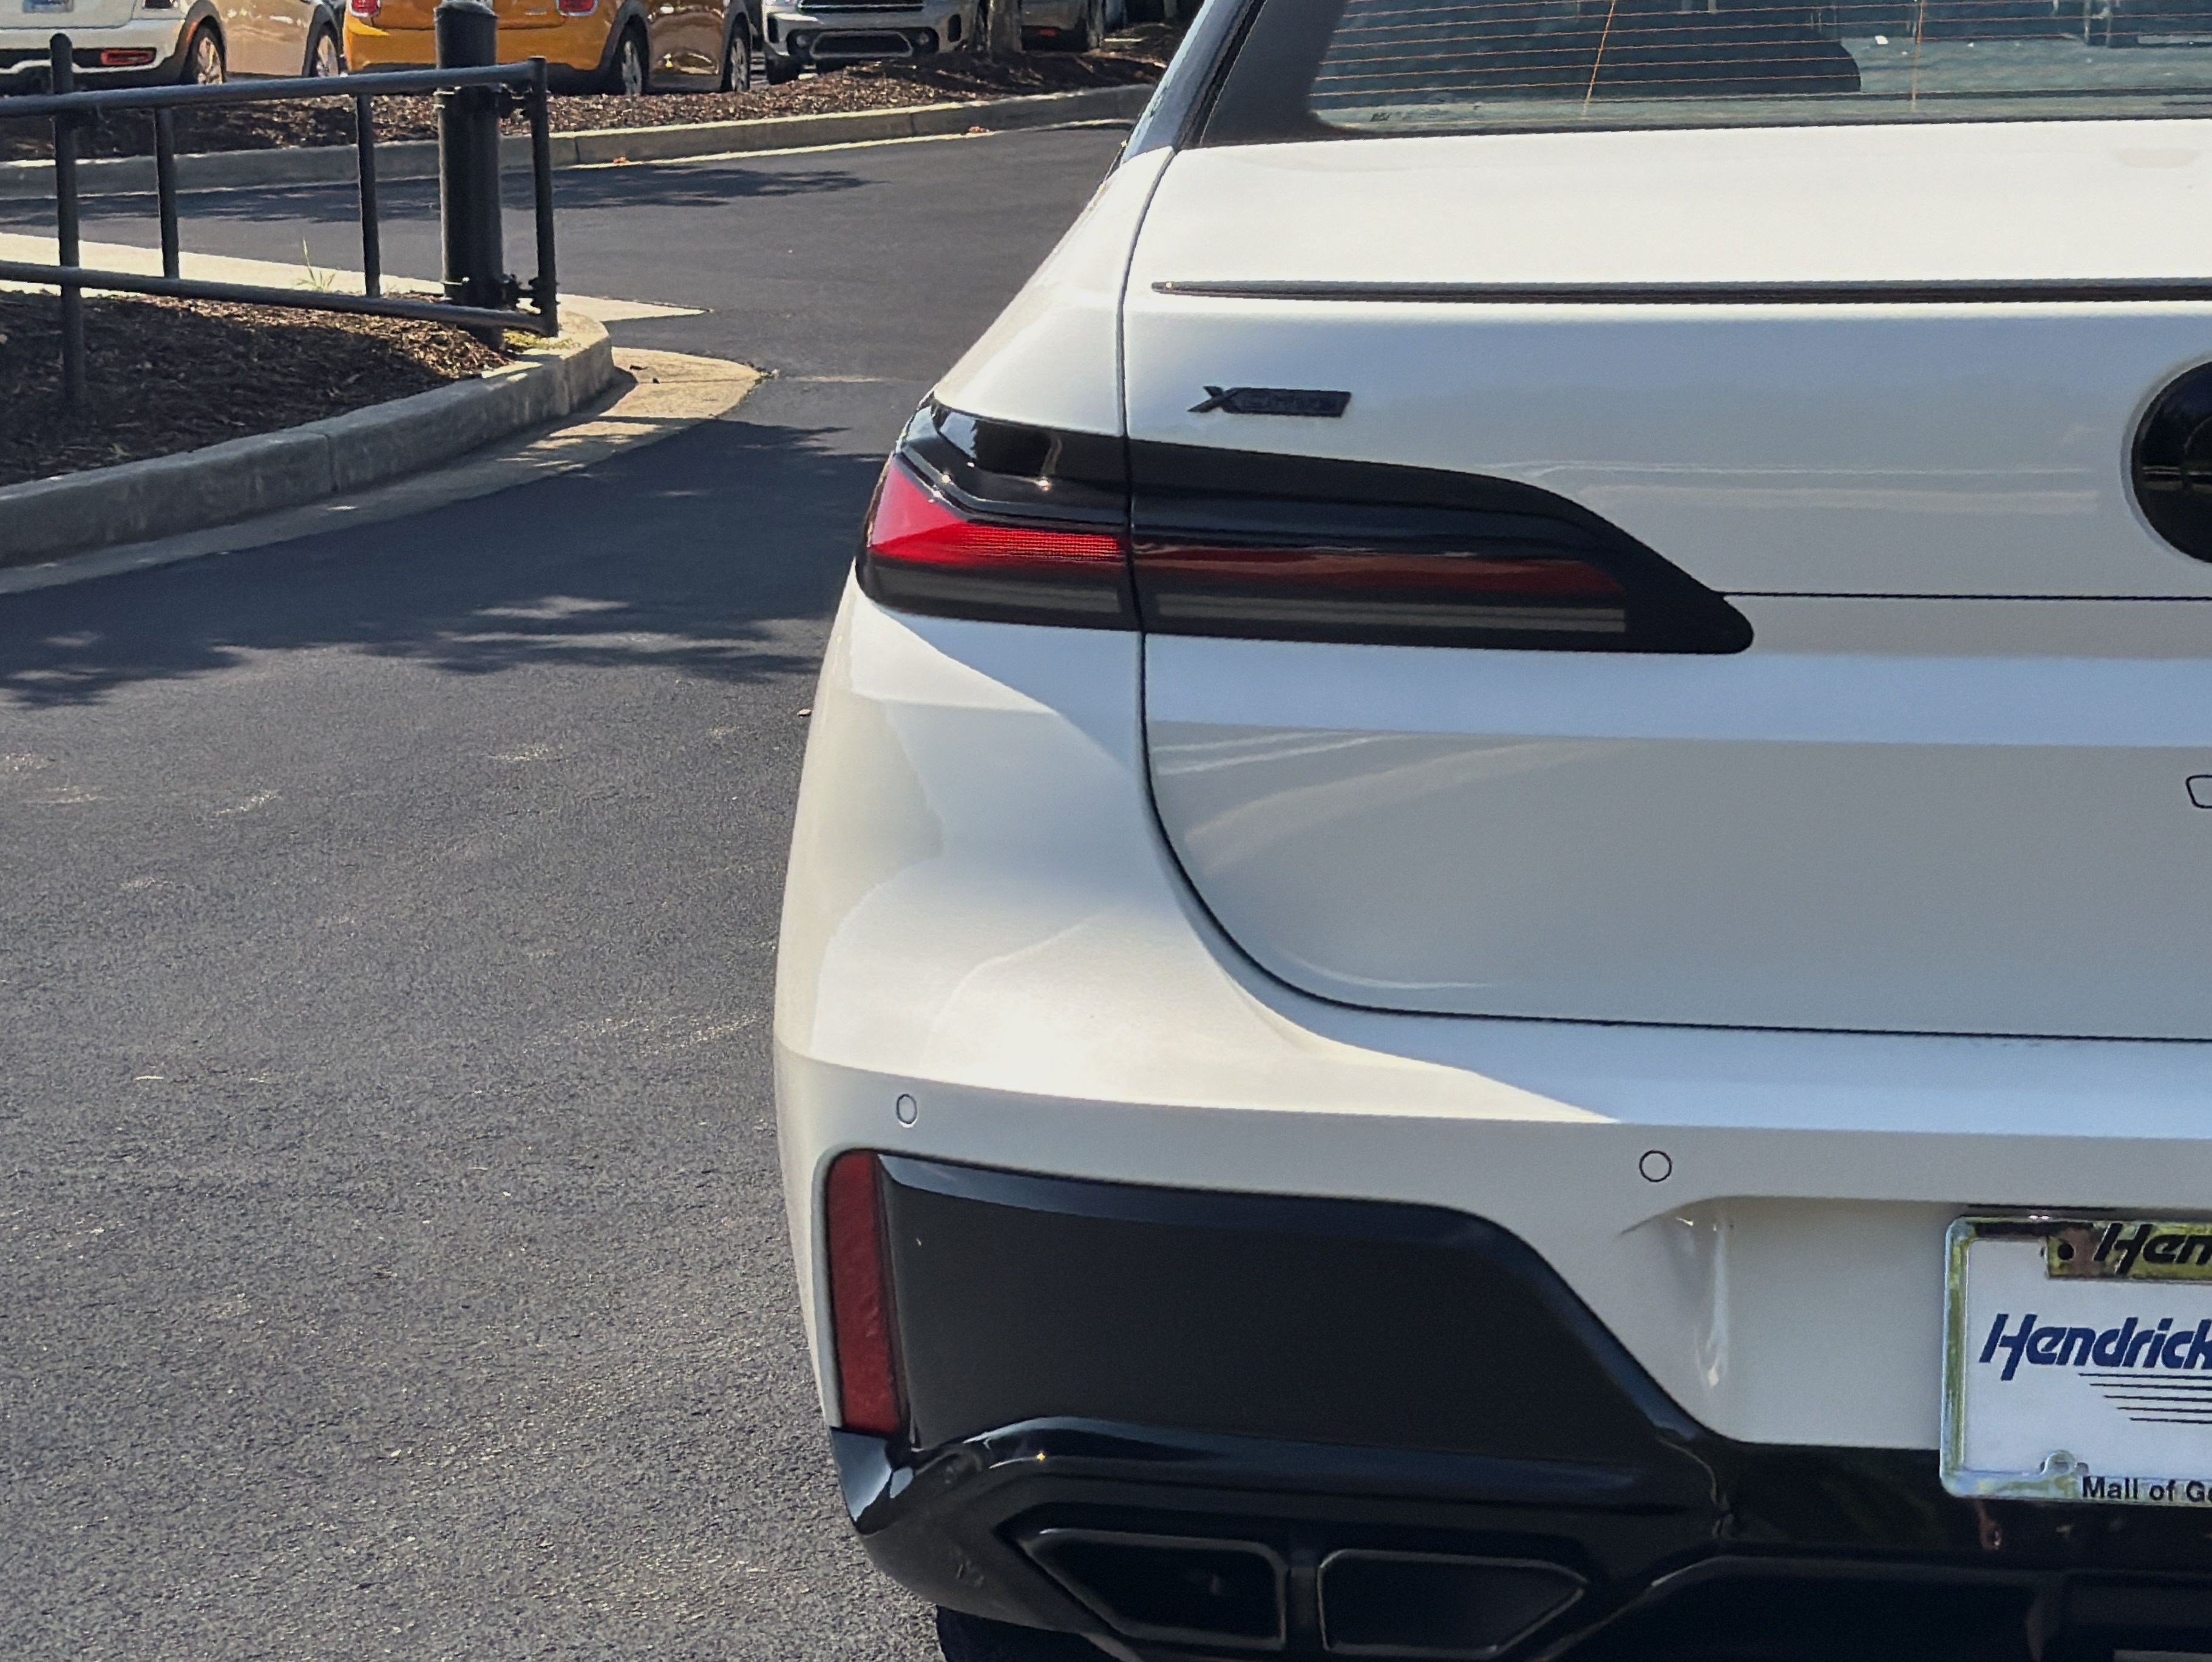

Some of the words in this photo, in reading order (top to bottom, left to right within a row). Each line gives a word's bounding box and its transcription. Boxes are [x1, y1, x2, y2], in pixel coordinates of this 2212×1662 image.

[2082, 1476, 2138, 1499] Mall
[2149, 1479, 2176, 1501] of
[2186, 1480, 2212, 1502] G
